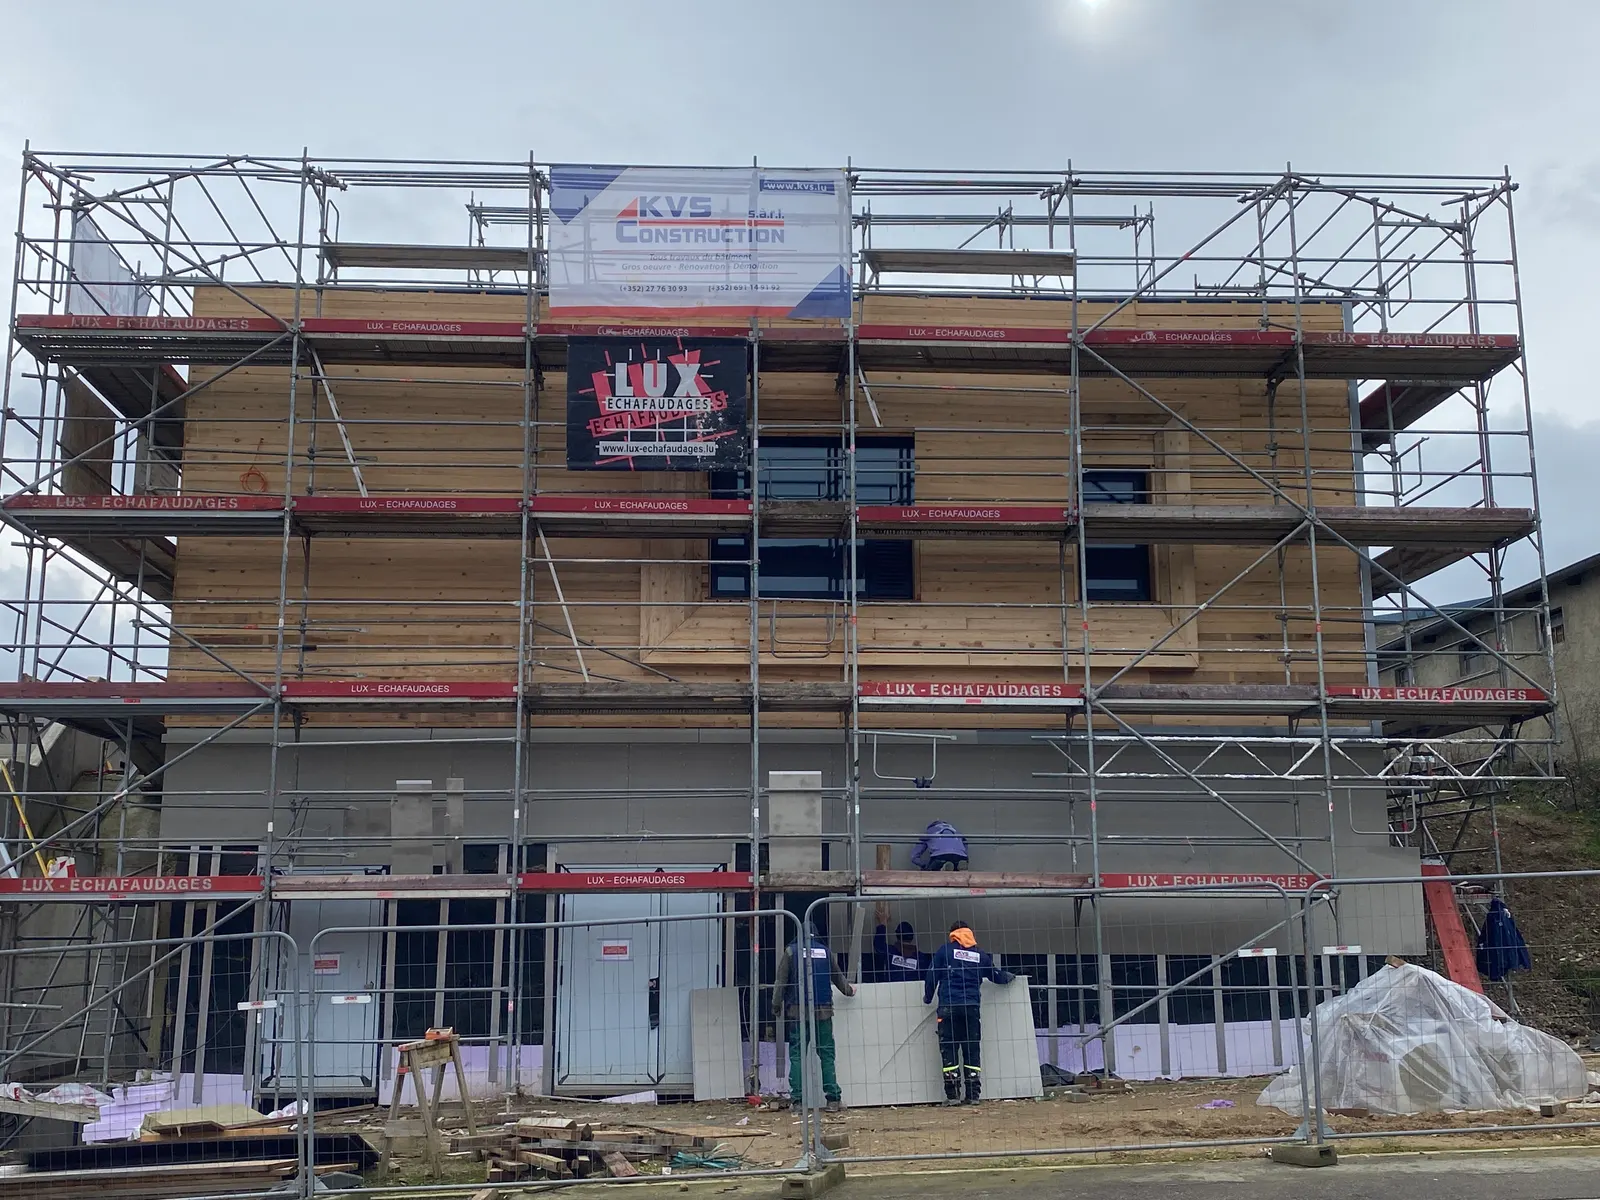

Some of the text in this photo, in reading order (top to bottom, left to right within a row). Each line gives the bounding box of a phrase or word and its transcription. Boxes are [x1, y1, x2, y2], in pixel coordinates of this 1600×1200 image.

[766, 181, 827, 192] www.kvs.lu
[639, 195, 712, 218] KVS
[616, 220, 785, 244] CONSTRUCTION
[702, 253, 714, 261] du
[621, 263, 641, 271] Gros
[679, 262, 726, 271] Rénovation
[733, 261, 779, 270] Démolition
[619, 285, 644, 293] (+352)
[367, 322, 384, 330] LUX
[393, 323, 462, 332] ECHAFAUDAGES
[622, 328, 689, 337] ECHAFAUDAGES
[909, 328, 926, 336] LUX
[935, 329, 1006, 338] ECHAFAUDAGES
[1165, 333, 1232, 342] ECHAFAUDAGES
[1328, 333, 1356, 344] LUX
[1371, 334, 1496, 346] ECHAFAUDAGES
[615, 362, 701, 397] LUX
[607, 398, 709, 410] ECHAFAUDAGES
[602, 443, 715, 455] www.lux-echafaudages.lu
[56, 497, 86, 508] LUX
[102, 497, 239, 509] ECHAFAUDAGES
[360, 501, 377, 509] LUX
[386, 500, 457, 509] ECHAFAUDAGES
[594, 501, 612, 509] LUX
[620, 501, 688, 510] ECHAFAUDAGES
[902, 509, 920, 518] LUX
[928, 509, 1000, 518] ECHAFAUDAGES
[351, 684, 368, 693] LUX
[378, 684, 450, 693] ECHAFAUDAGES
[887, 684, 916, 696] LUX
[930, 684, 1062, 696] ECHAFAUDAGES
[1395, 687, 1527, 700] ECHAFAUDAGES
[22, 879, 54, 892] LUX
[70, 878, 212, 891] ECHAFAUDAGES
[587, 876, 605, 885] LUX
[614, 875, 685, 884] ECHAFAUDAGES
[1128, 875, 1158, 887] LUX
